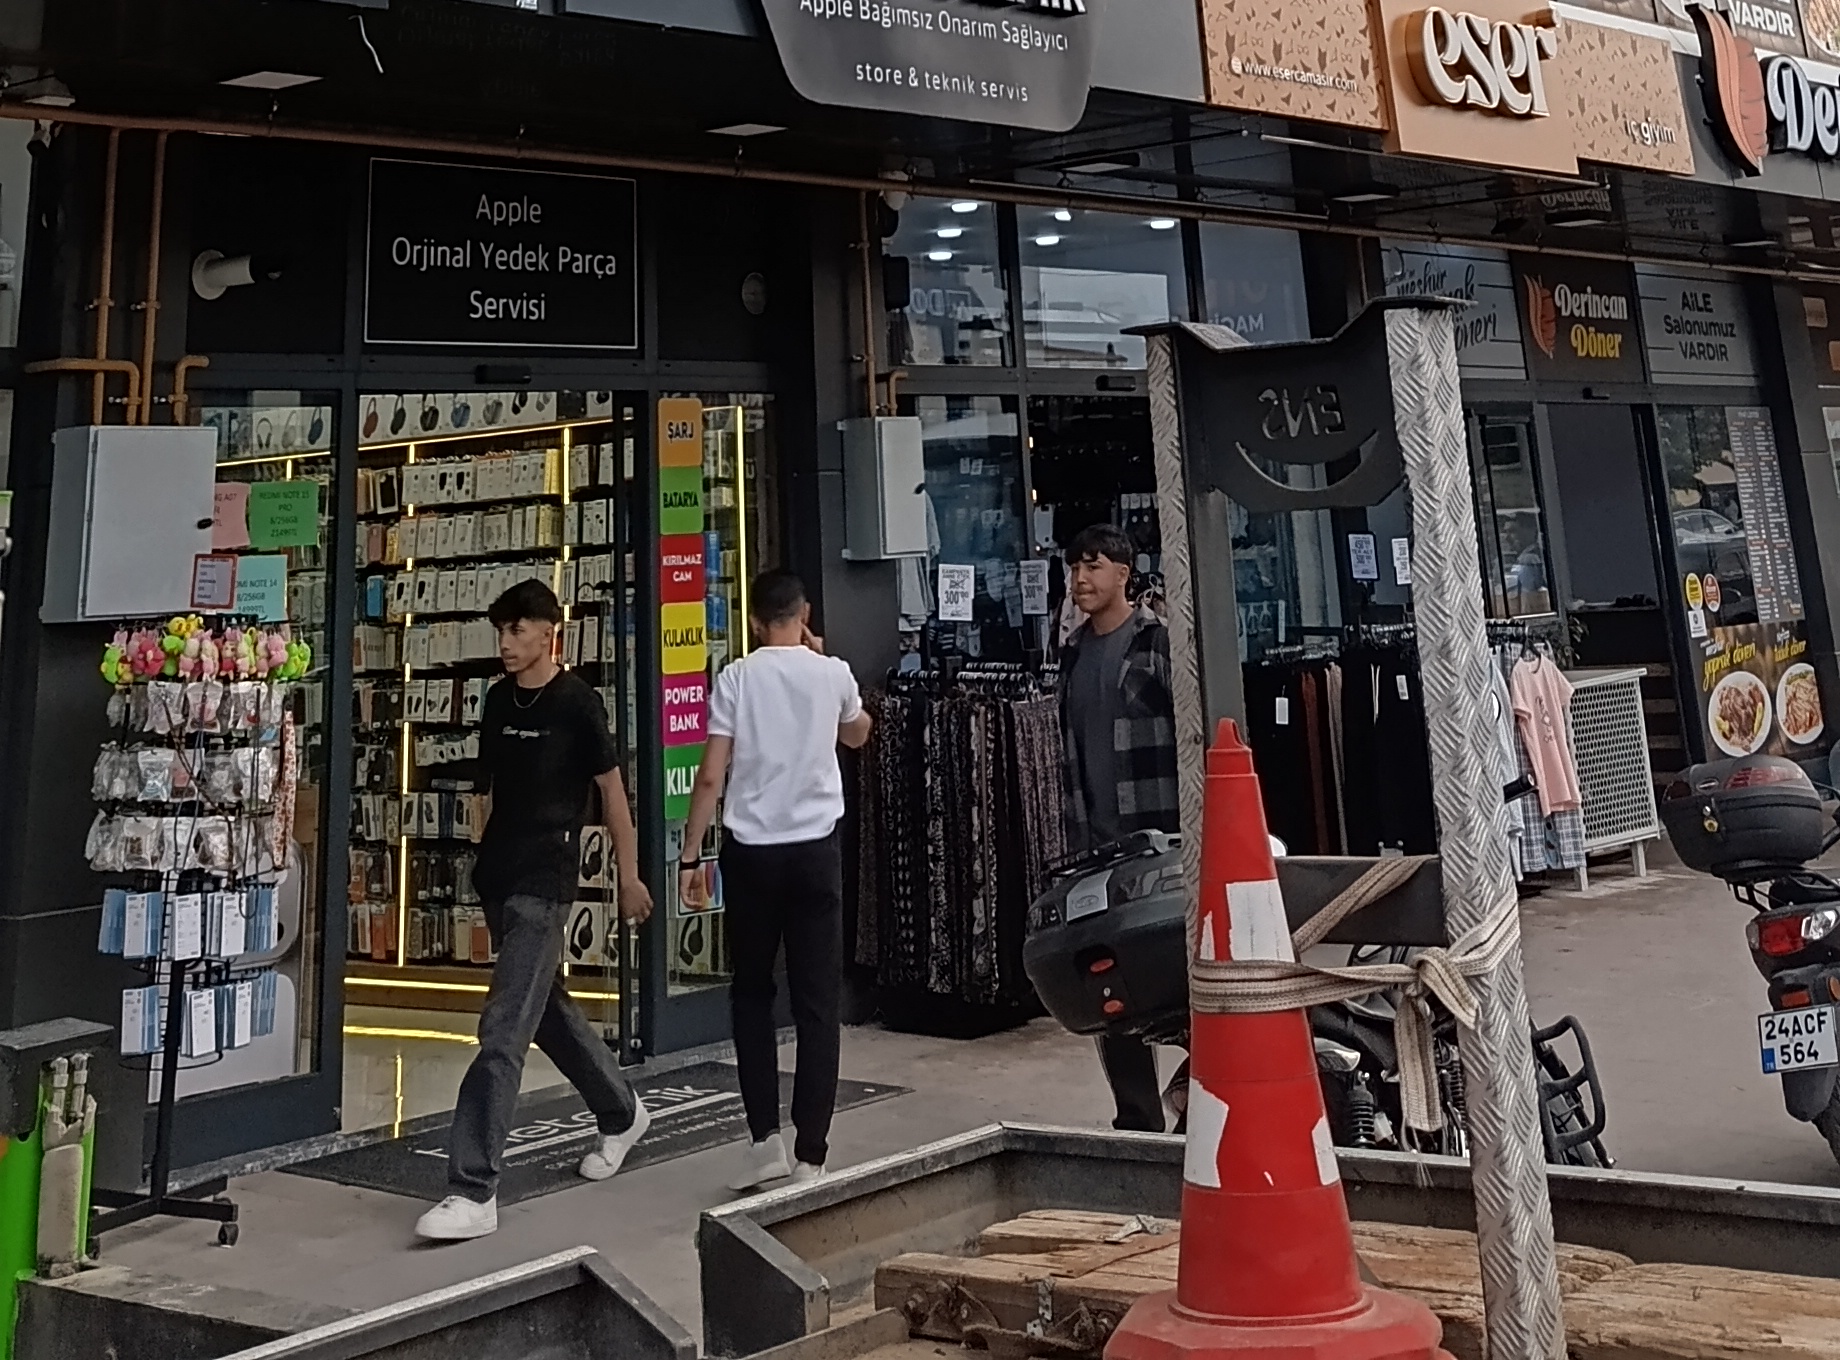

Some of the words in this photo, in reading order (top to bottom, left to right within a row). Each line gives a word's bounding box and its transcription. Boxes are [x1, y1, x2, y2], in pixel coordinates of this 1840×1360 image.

[938, 9, 998, 40] Onarım
[1000, 19, 1069, 54] Sağlayıcı
[1421, 5, 1558, 117] eser
[855, 61, 902, 87] store
[908, 68, 920, 88] &
[924, 69, 976, 96] teknik
[980, 77, 1029, 103] servis
[1766, 54, 1840, 156] De
[1640, 116, 1677, 147] giyim
[475, 193, 542, 227] Apple
[392, 236, 471, 272] Orjinal
[479, 241, 550, 272] Yedek
[558, 245, 617, 280] Parça
[469, 289, 546, 321] Servisi
[1554, 283, 1628, 320] Derincan
[1663, 314, 1737, 338] Salonumuz
[1570, 323, 1622, 358] Döner
[1678, 340, 1729, 362] VARDIR
[667, 421, 694, 444] ŞARJ
[663, 491, 699, 508] BATARYA
[662, 553, 702, 566] KIRILMAZ
[672, 570, 692, 582] CAM
[663, 626, 704, 649] KULAKLIK
[664, 685, 704, 706] POWER
[669, 712, 700, 732] BANK
[1780, 1040, 1819, 1065] 564
